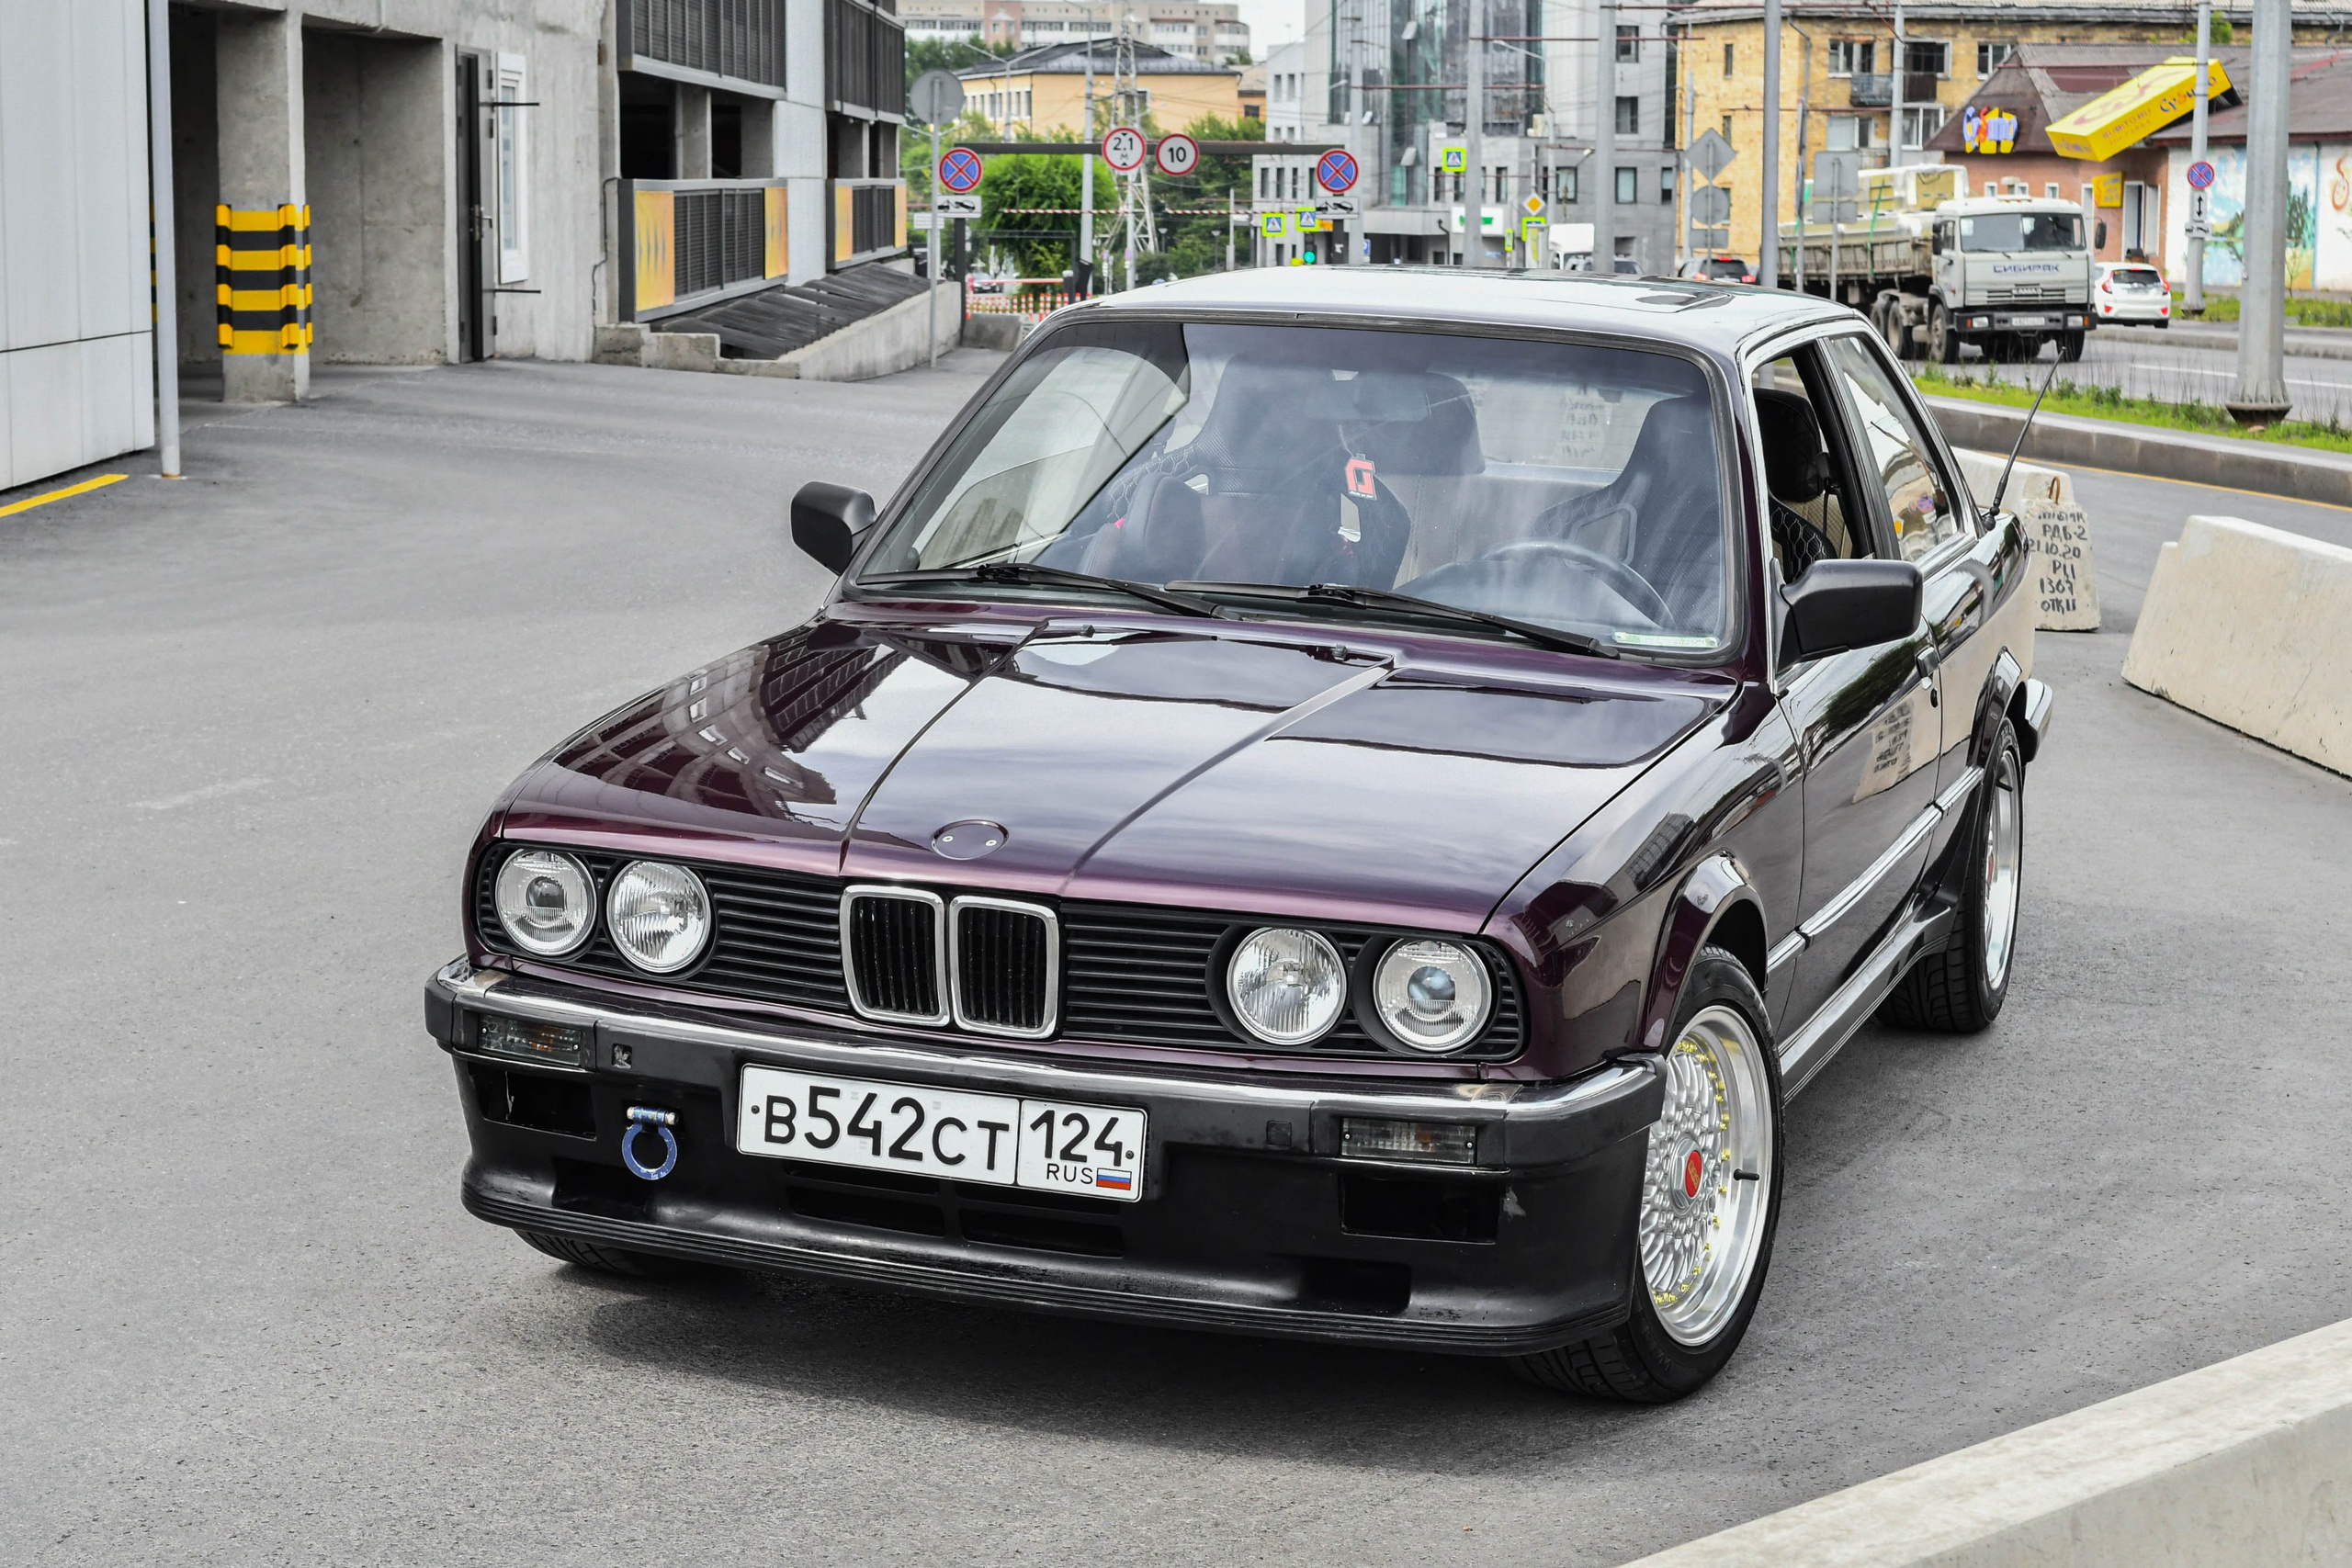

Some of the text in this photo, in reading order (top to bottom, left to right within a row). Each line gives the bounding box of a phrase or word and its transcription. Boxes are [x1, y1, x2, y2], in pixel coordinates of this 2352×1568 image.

[2160, 76, 2217, 112] Субио
[1113, 137, 1134, 151] 2.1
[1168, 146, 1187, 163] 10
[1994, 264, 2061, 273] СИБИРЯК
[1029, 1110, 1124, 1168] 124
[1046, 1163, 1094, 1185] RUS
